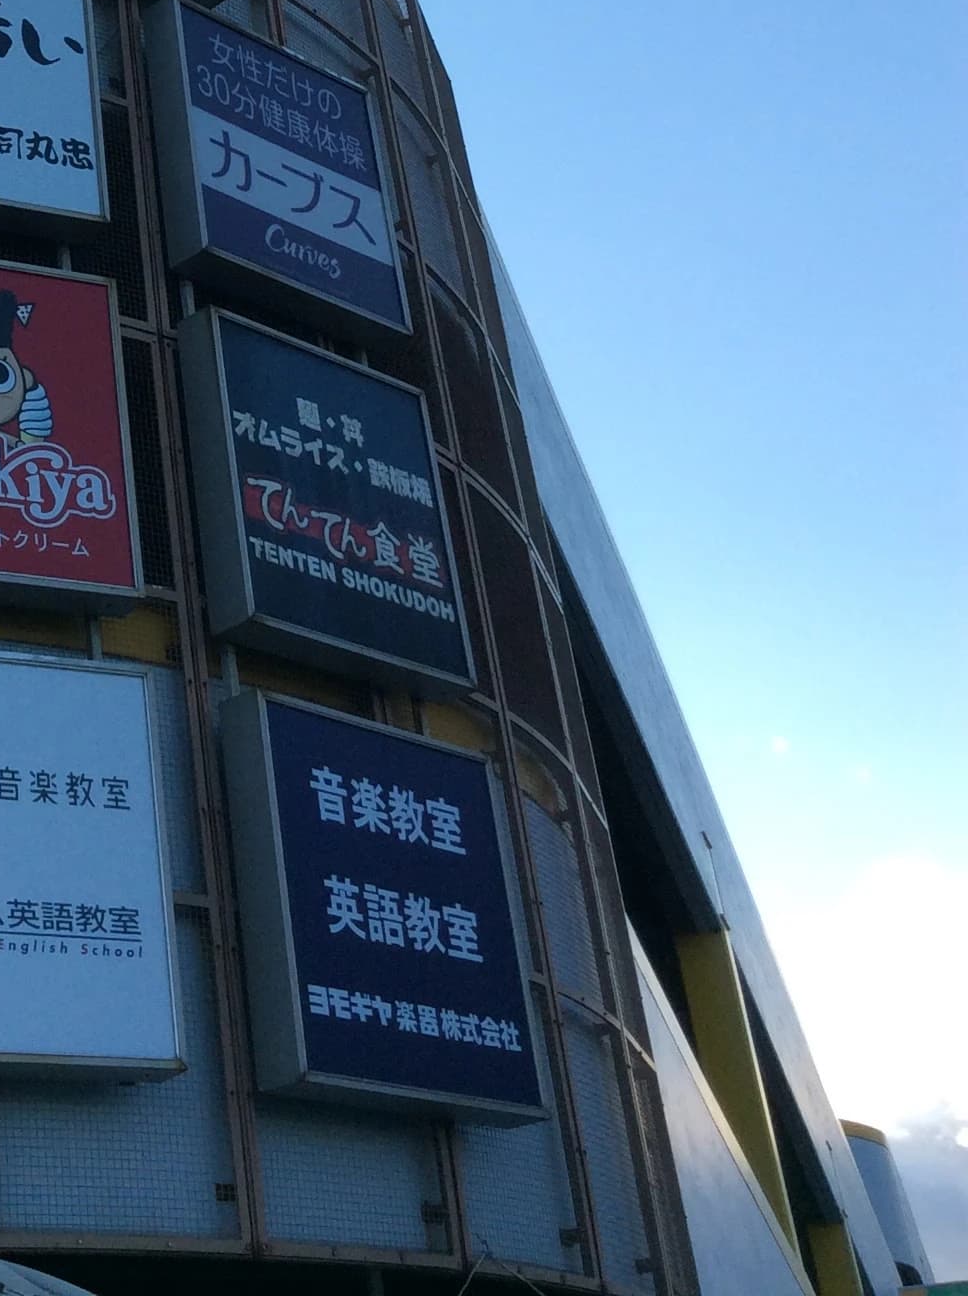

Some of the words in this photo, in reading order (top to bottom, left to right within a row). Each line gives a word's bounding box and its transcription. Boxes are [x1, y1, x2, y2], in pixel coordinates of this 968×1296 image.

[197, 65, 368, 172] 30分健康体操
[209, 34, 342, 120] 女性だけの
[209, 130, 377, 246] カーブス
[265, 223, 341, 279] Curves
[248, 476, 443, 589] てんてん食堂
[249, 536, 337, 584] TENTEN
[342, 567, 455, 623] SHOKUDOH
[310, 766, 466, 856] 音楽教室
[80, 944, 143, 959] School
[324, 874, 484, 963] 英語教室
